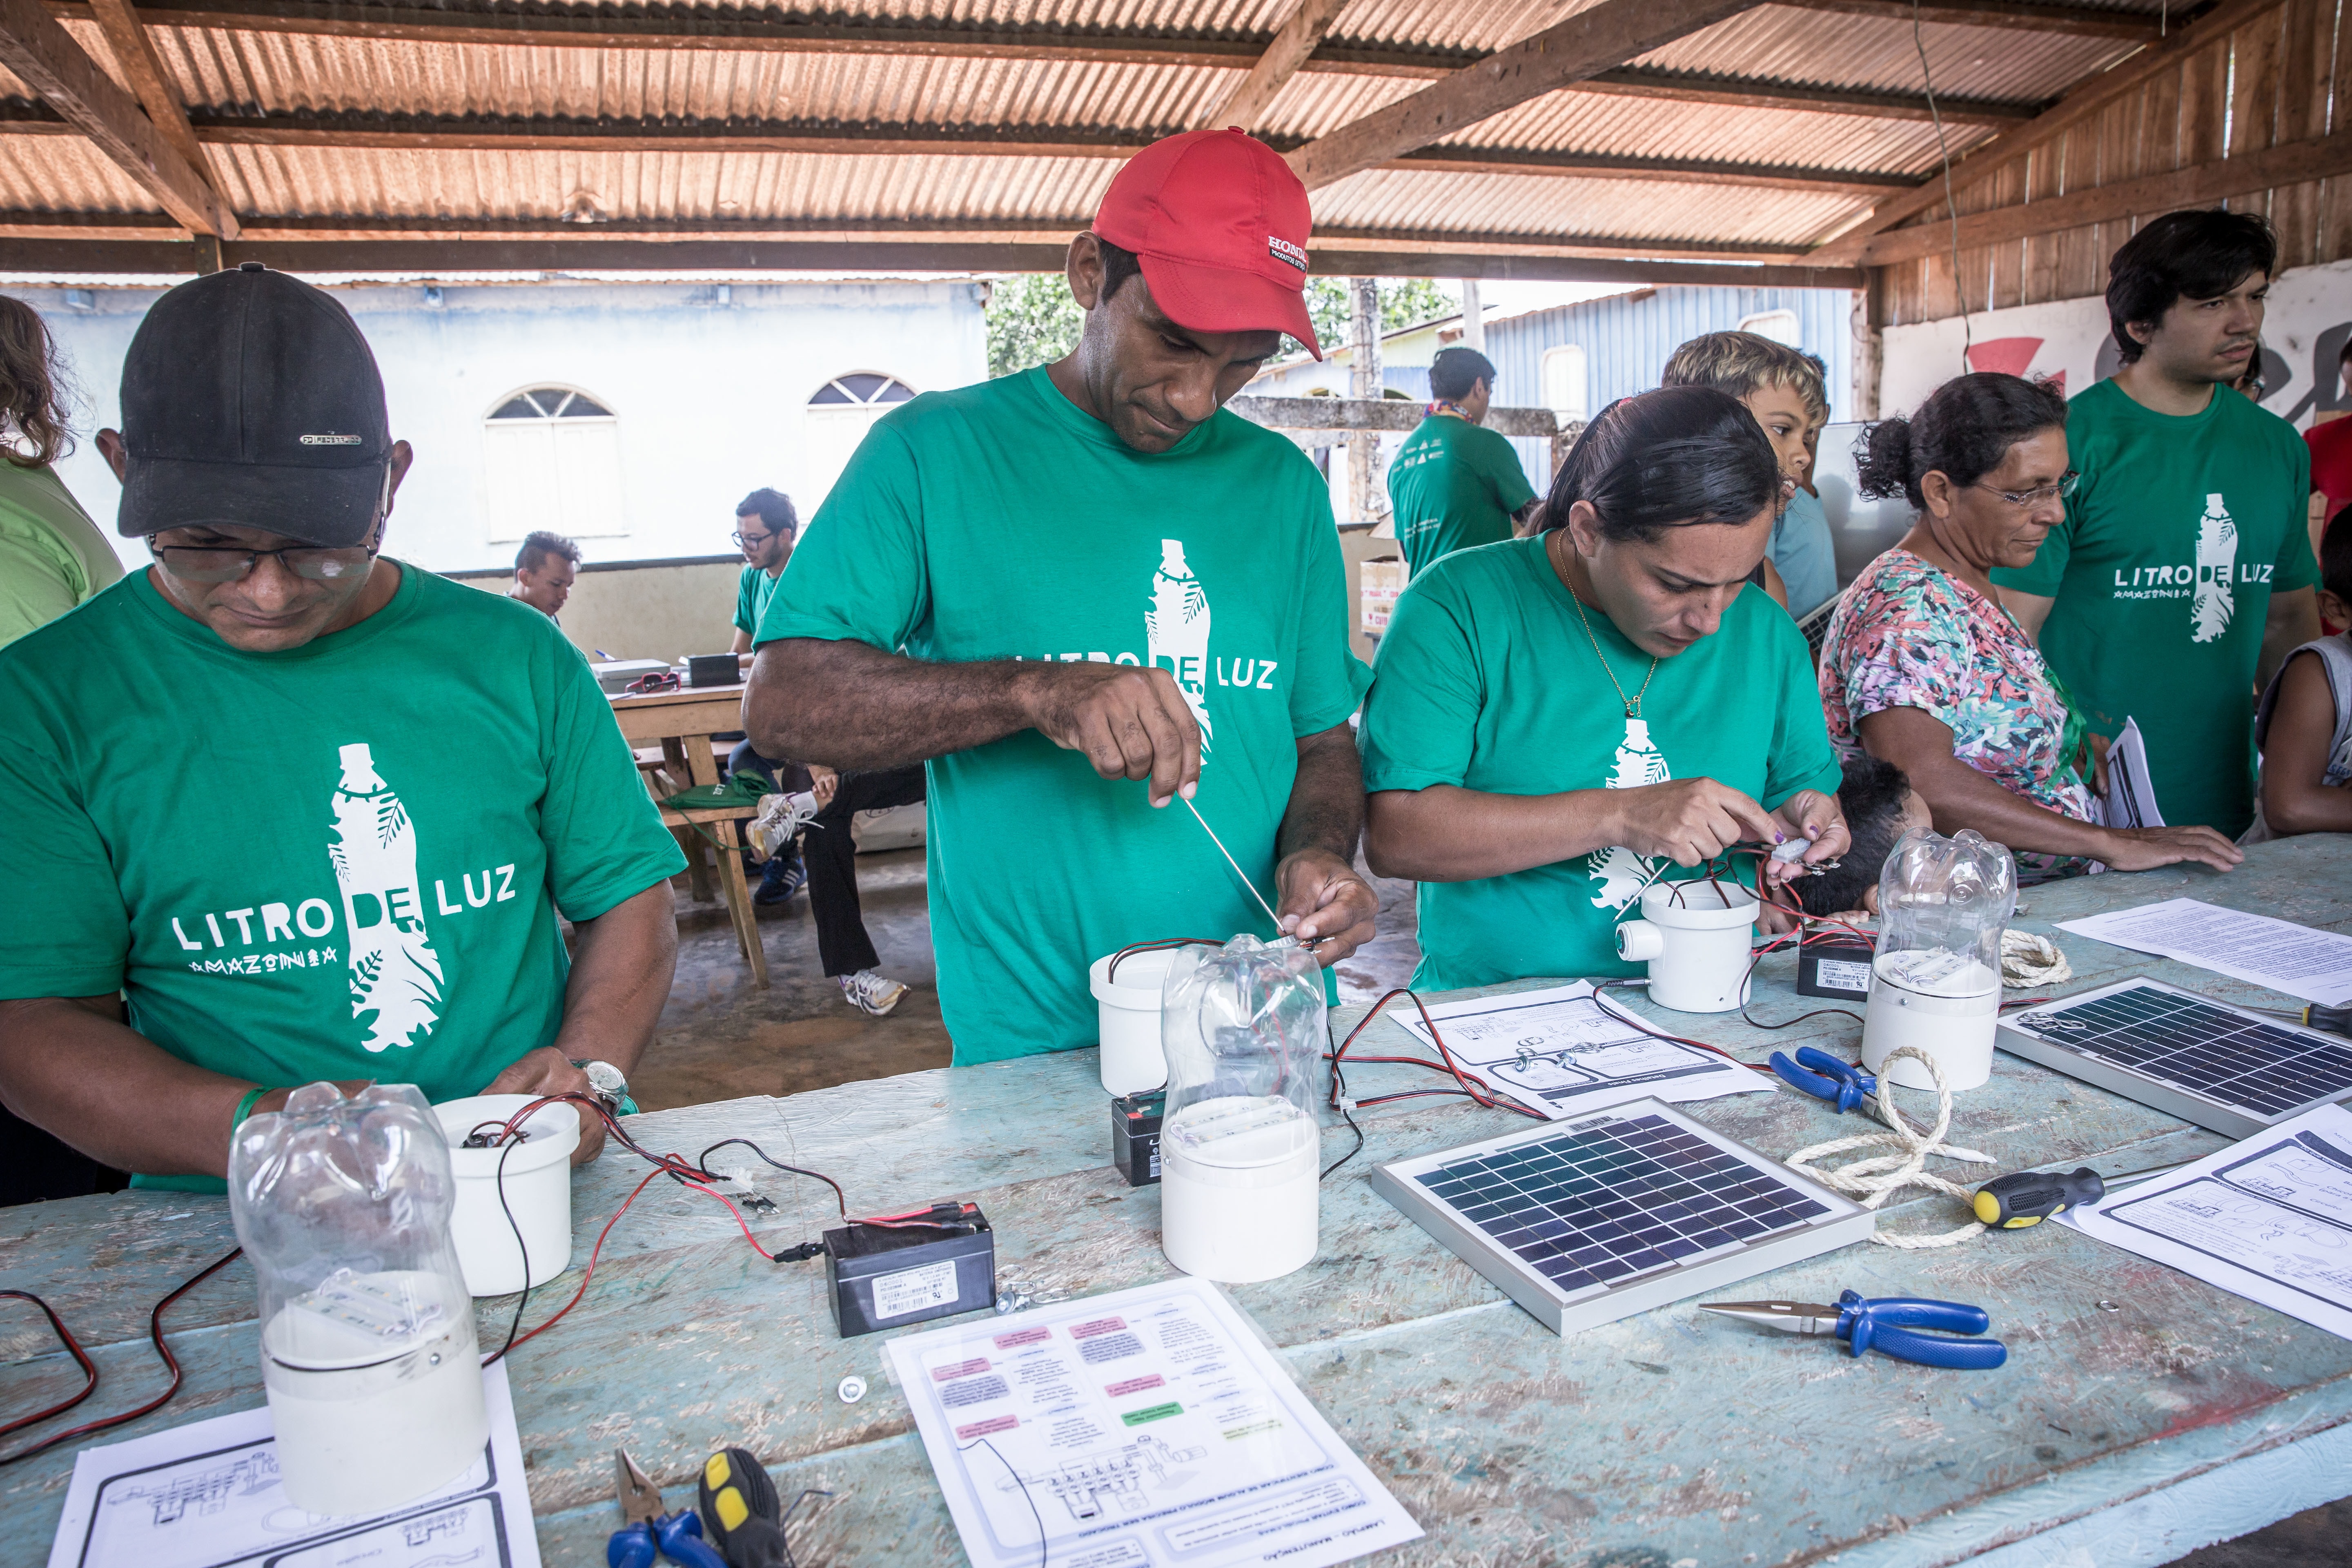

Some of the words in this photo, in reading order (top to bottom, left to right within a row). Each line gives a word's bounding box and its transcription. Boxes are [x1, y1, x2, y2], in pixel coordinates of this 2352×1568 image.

[1269, 236, 1306, 262] HONDA
[1272, 249, 1294, 264] PRODUTOS
[2115, 565, 2193, 586] LITRO
[2201, 566, 2228, 583] DE
[2241, 564, 2274, 583] LUZ
[1216, 657, 1277, 689] LUZ
[172, 897, 334, 951] LITRO
[350, 887, 414, 930] DE
[435, 863, 516, 917] LUZ
[1632, 1074, 1666, 1082] Detalhes
[2309, 1150, 2321, 1159] que
[2321, 1157, 2343, 1169] vamos
[2319, 1188, 2341, 1197] (para
[2310, 1198, 2342, 1210] Circuito
